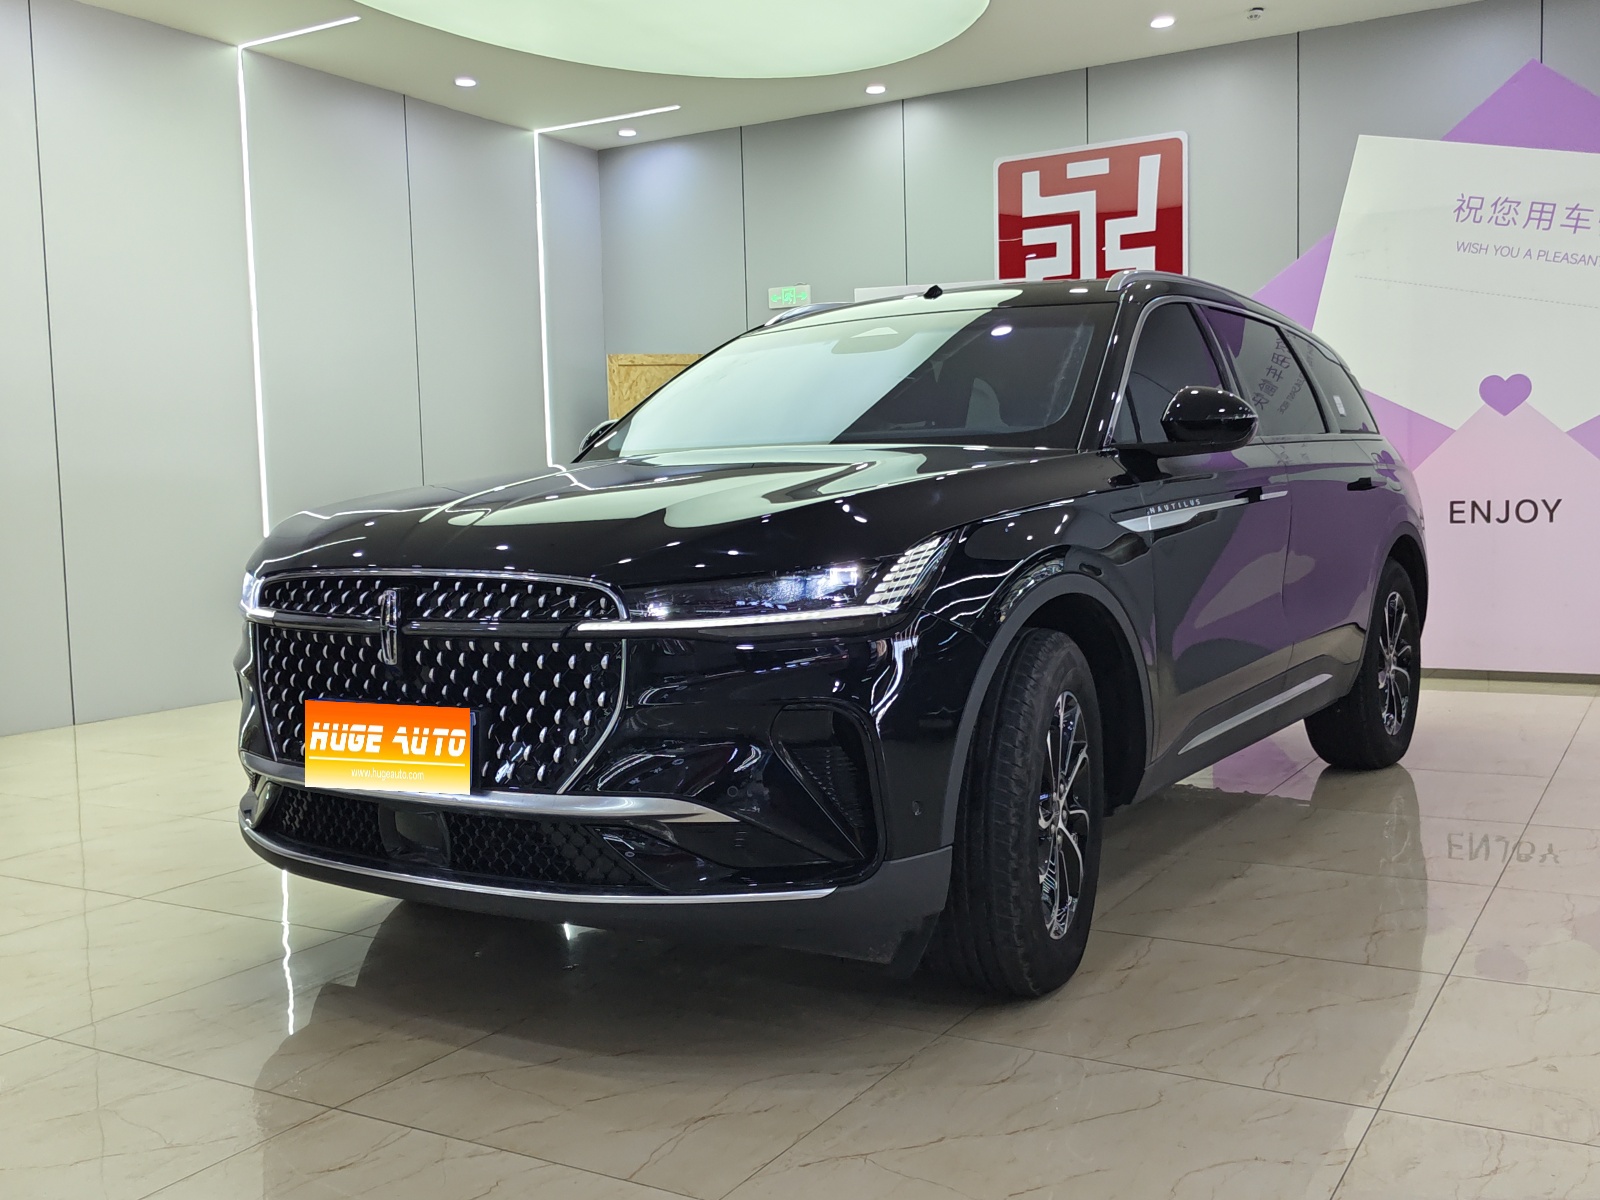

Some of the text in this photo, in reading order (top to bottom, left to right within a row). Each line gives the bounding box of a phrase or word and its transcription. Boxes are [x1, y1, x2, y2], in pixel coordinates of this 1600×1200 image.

[1453, 193, 1600, 234] 祝您用车
[1456, 240, 1600, 267] WISH YOU A PLEASAN
[1149, 498, 1201, 514] NAUTILUS
[1449, 498, 1562, 524] ENJOY
